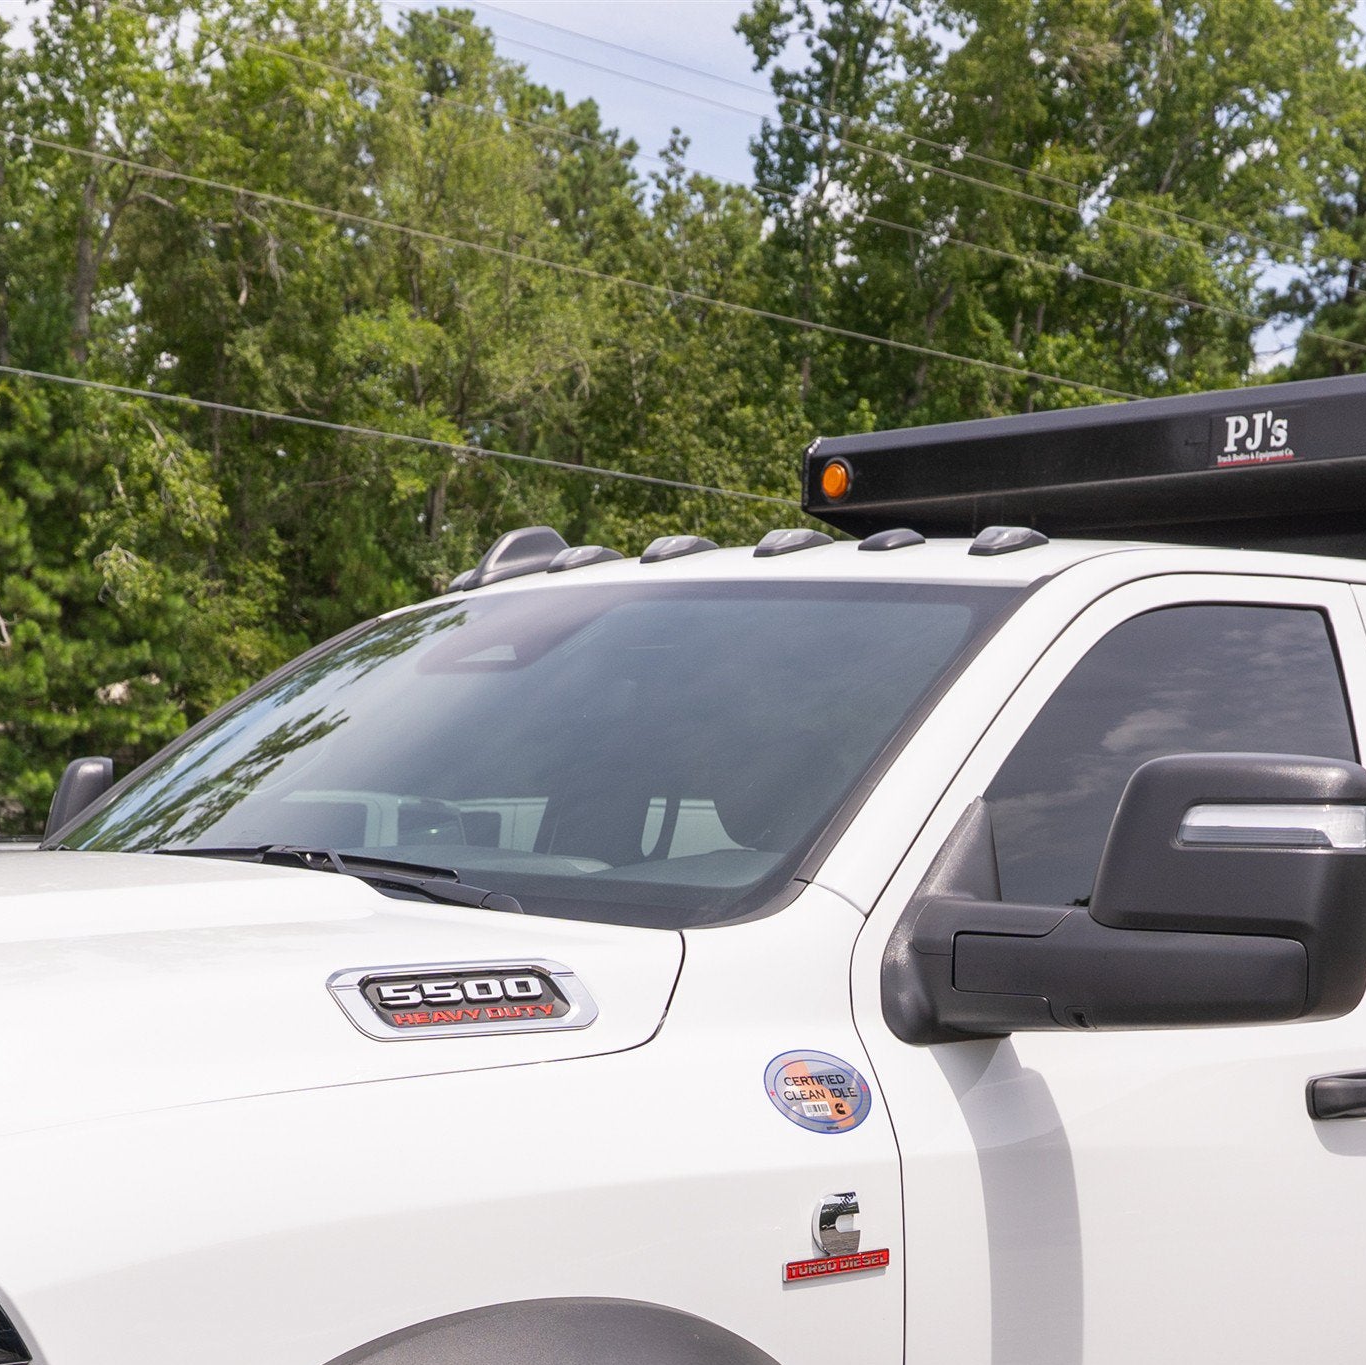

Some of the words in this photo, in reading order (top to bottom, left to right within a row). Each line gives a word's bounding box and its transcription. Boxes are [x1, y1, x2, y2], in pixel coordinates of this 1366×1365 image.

[1223, 410, 1288, 453] PJ's
[379, 977, 543, 1008] 5500
[392, 1009, 481, 1026] HEAVY
[485, 1003, 554, 1019] DUTY
[783, 1074, 846, 1087] CERTIFIED
[783, 1089, 826, 1101] CLEAN
[829, 1087, 858, 1099] IDLE
[788, 1260, 837, 1277] TURBO
[839, 1254, 888, 1270] DIESEL
